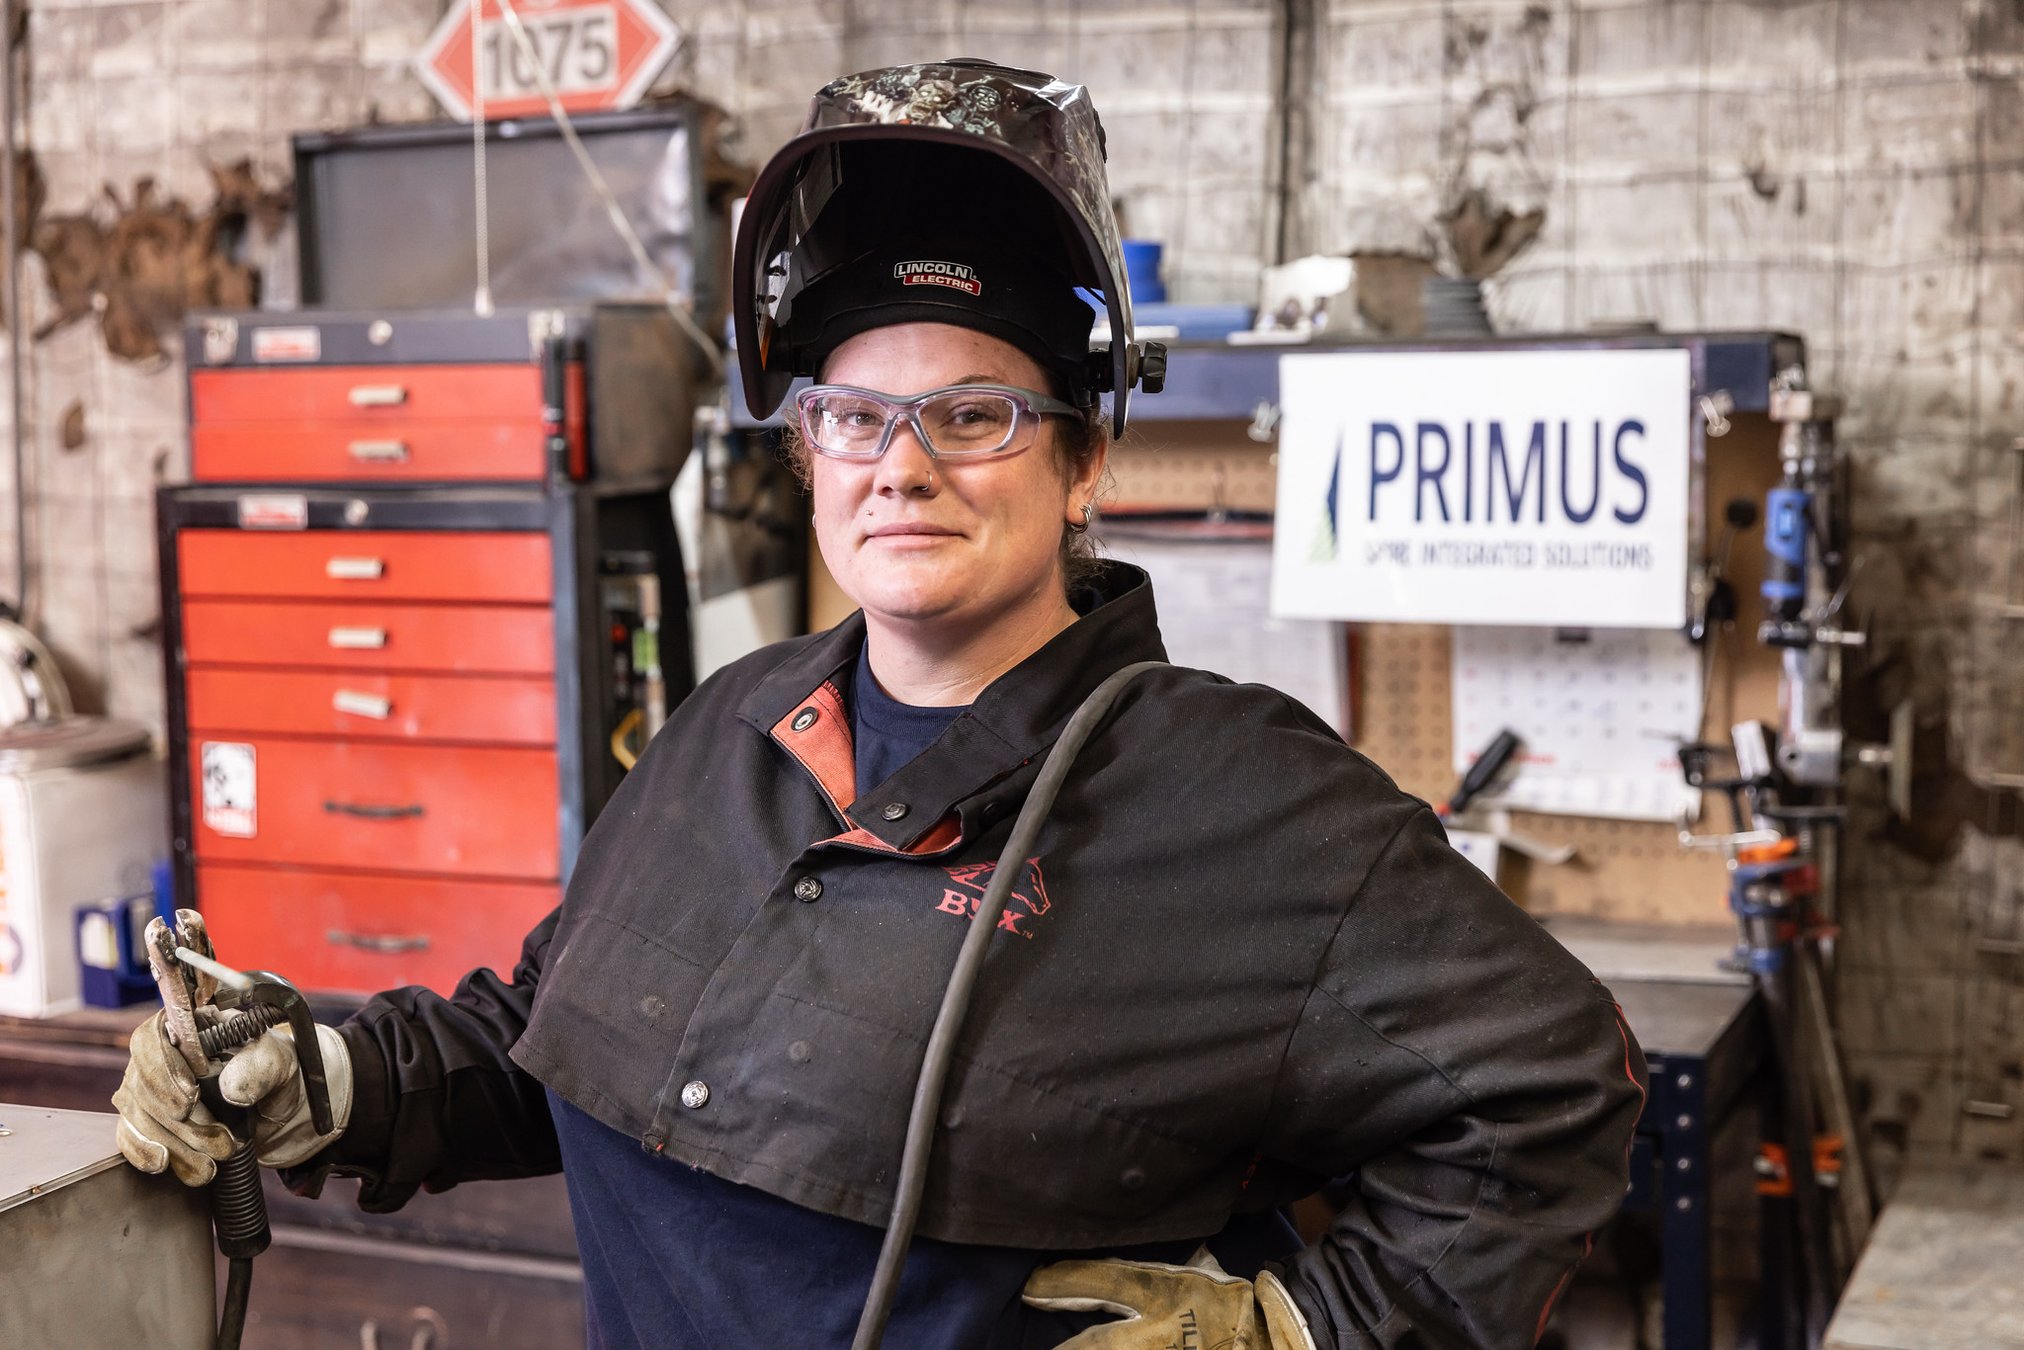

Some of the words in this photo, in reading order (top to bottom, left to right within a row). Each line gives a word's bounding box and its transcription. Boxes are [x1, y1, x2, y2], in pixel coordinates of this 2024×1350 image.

[484, 17, 610, 89] 1075
[898, 263, 968, 279] LINCOLN
[912, 275, 974, 291] ELECTRIC
[1367, 419, 1650, 525] PRIMUS
[1421, 541, 1535, 568] INTEGRATED
[1544, 542, 1654, 570] SOLUTIONS
[1179, 1308, 1198, 1350] TIL
